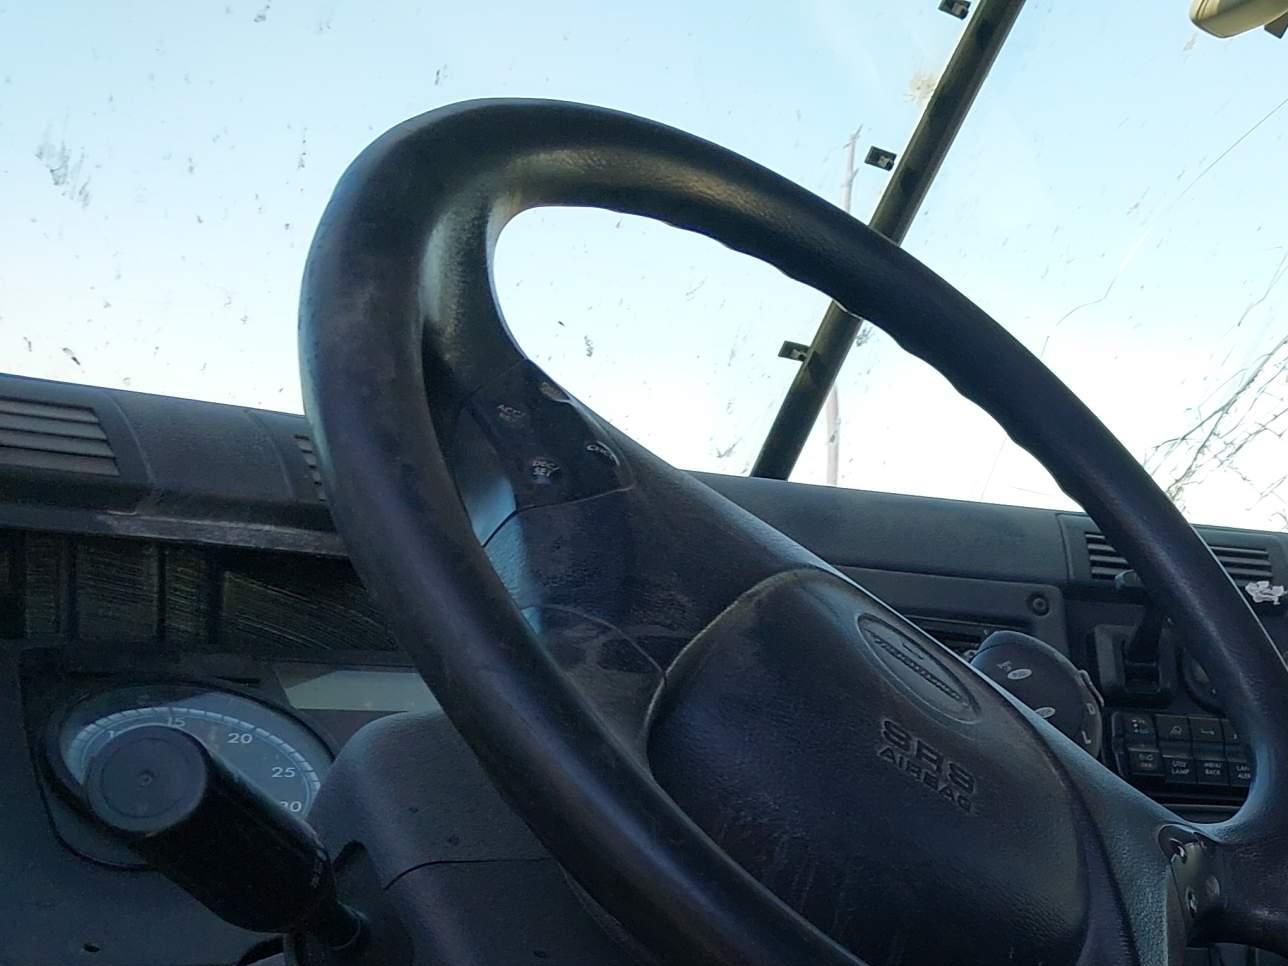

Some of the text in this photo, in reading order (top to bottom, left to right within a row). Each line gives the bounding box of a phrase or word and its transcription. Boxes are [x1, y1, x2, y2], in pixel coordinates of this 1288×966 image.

[227, 732, 254, 745] 20
[880, 717, 976, 795] SRS
[271, 766, 297, 779] 25
[877, 746, 974, 814] AIRBAG
